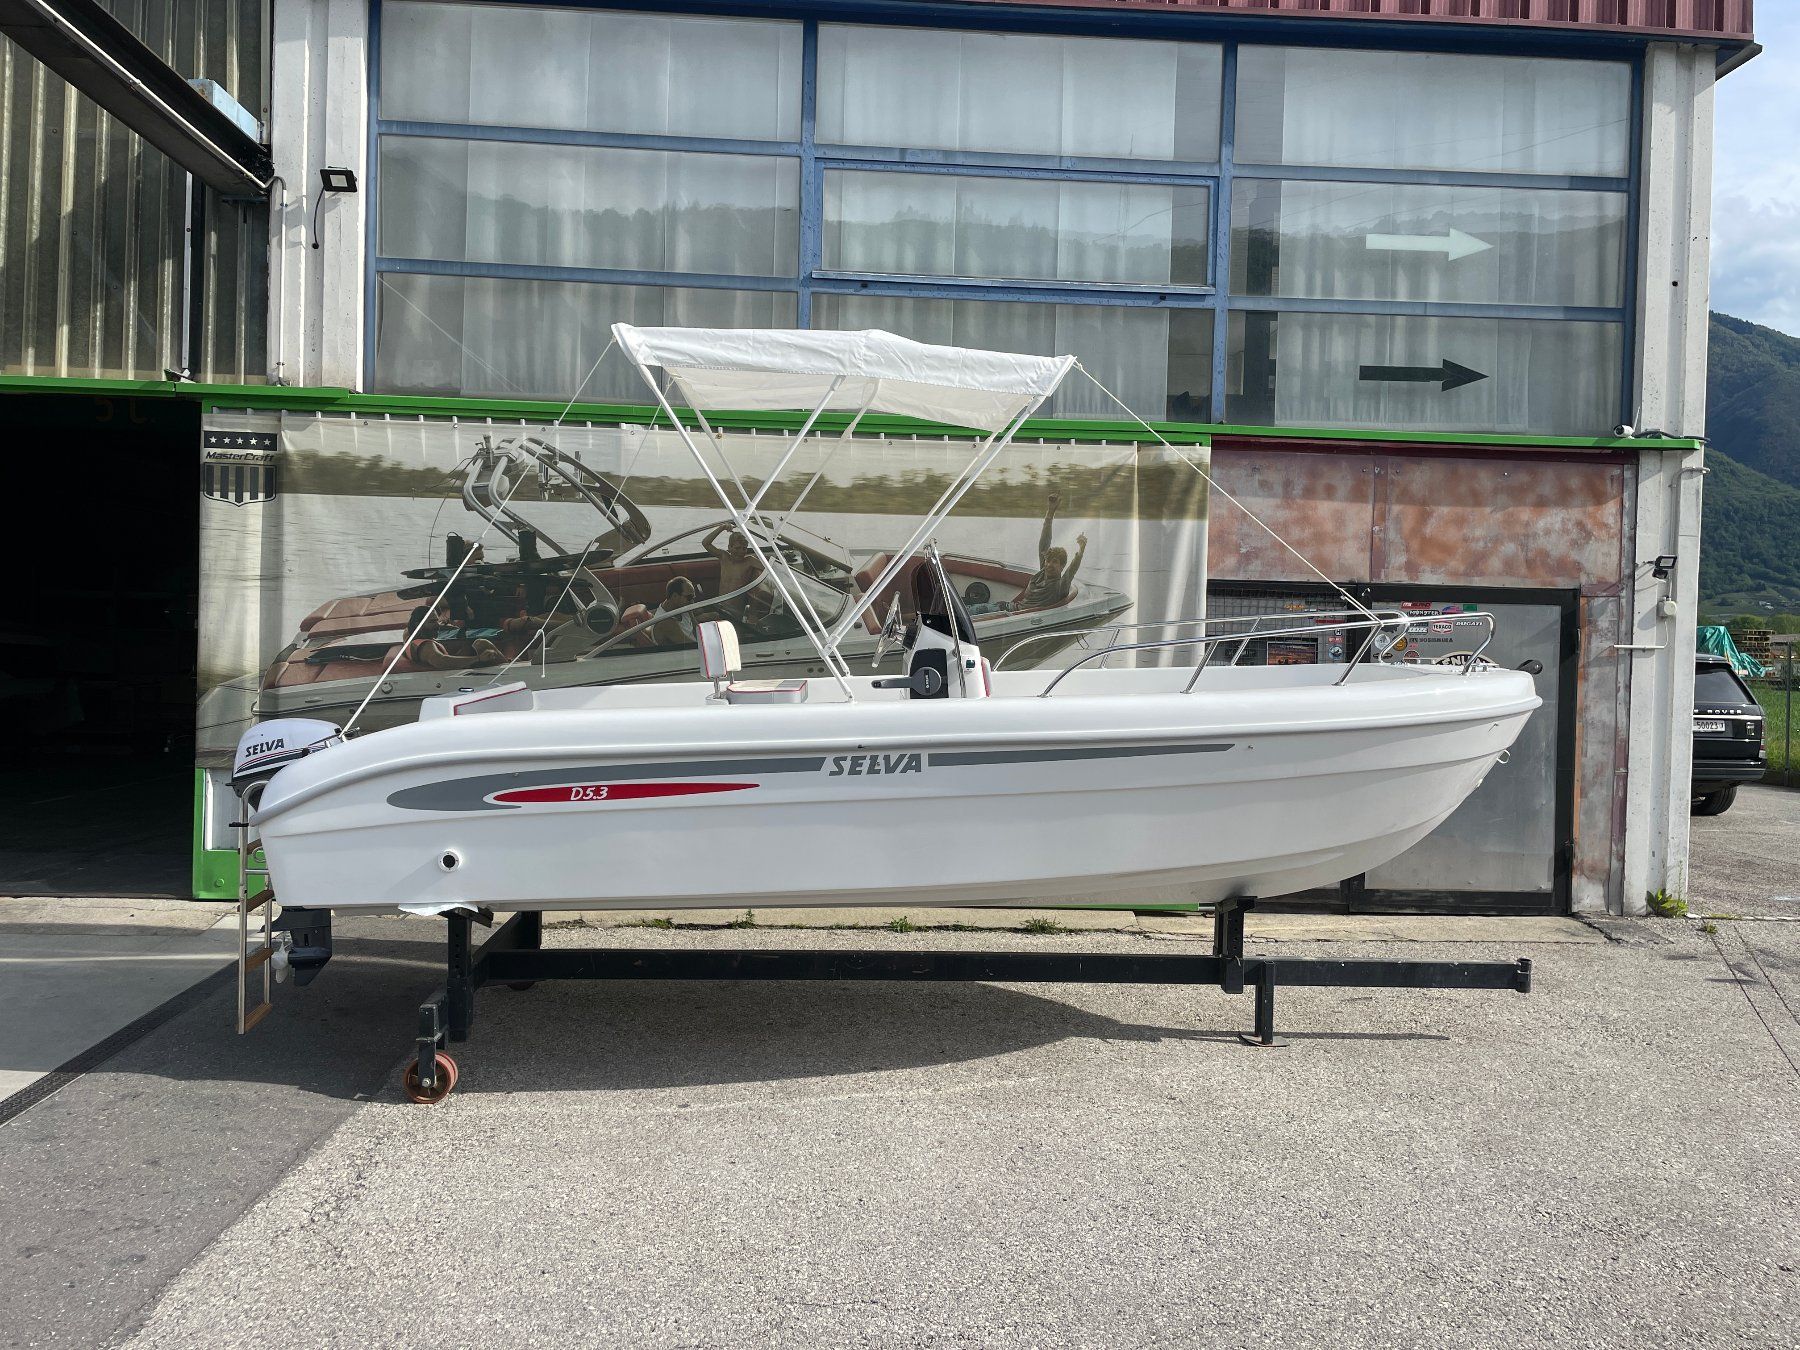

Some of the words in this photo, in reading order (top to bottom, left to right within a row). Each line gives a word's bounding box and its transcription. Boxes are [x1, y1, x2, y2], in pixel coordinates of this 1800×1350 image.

[206, 451, 274, 462] MasterCraft
[245, 738, 285, 757] SELVA
[829, 753, 922, 776] SELVA
[571, 786, 609, 801] D5.3
